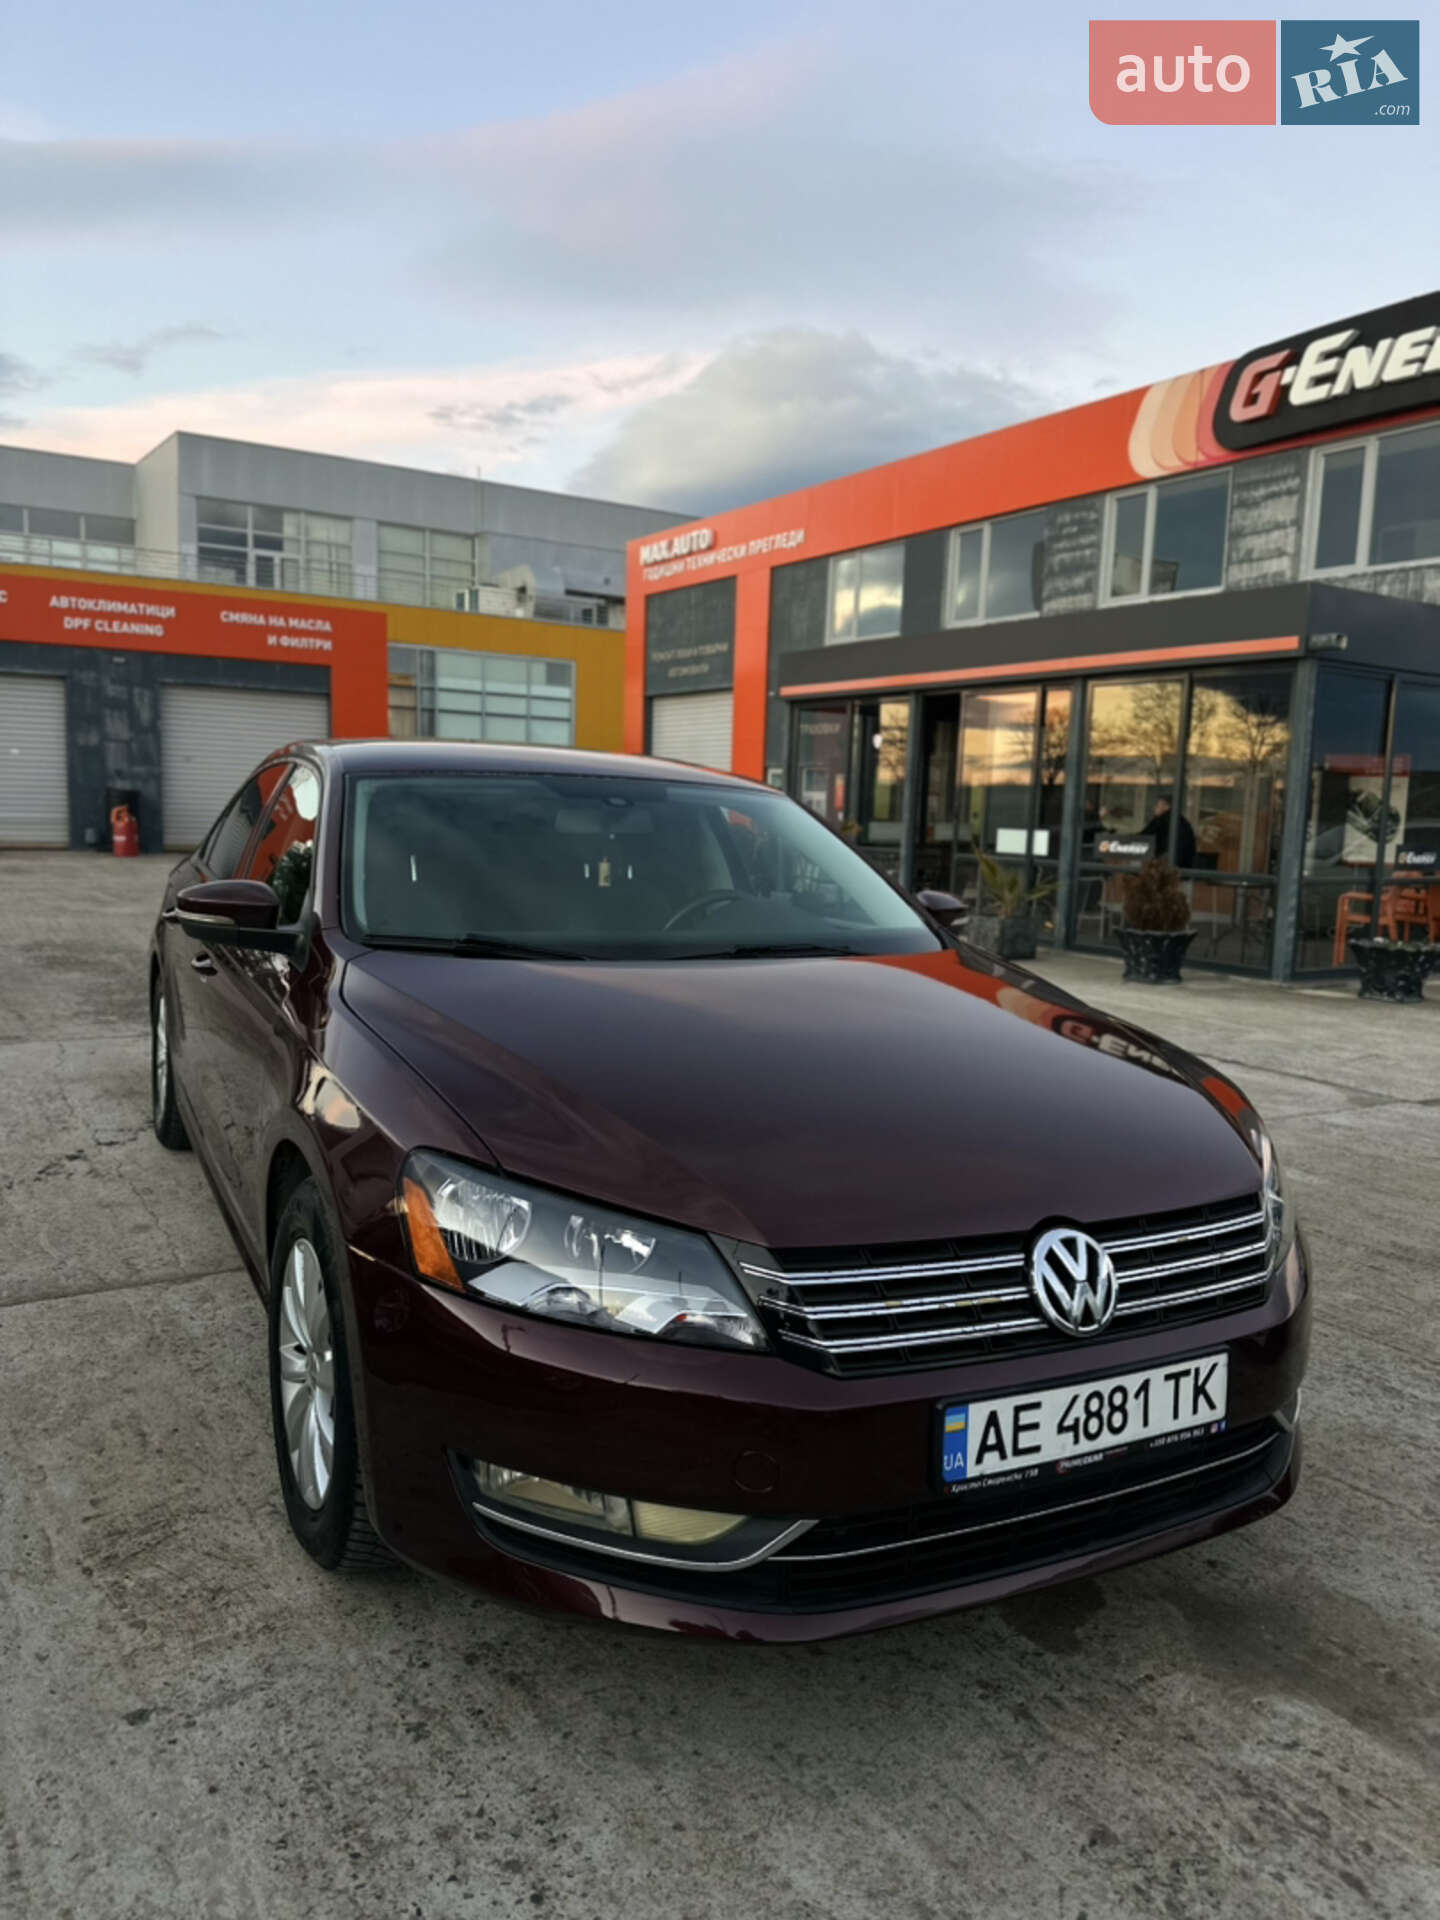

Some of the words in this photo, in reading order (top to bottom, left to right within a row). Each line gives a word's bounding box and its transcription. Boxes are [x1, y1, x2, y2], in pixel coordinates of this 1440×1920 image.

[49, 595, 176, 618] АВТОКЛИМАТИЦИ
[63, 616, 93, 631] DPF
[95, 619, 164, 637] CLEANING
[220, 610, 266, 627] СМЯНА
[268, 615, 286, 629] НА
[288, 617, 333, 633] МАСЛА
[267, 634, 278, 647] И
[279, 635, 333, 651] ФИЛТРИ
[974, 1401, 1042, 1466] AE
[1056, 1378, 1152, 1445] 4881
[1164, 1362, 1219, 1421] TK
[943, 1451, 964, 1471] UA
